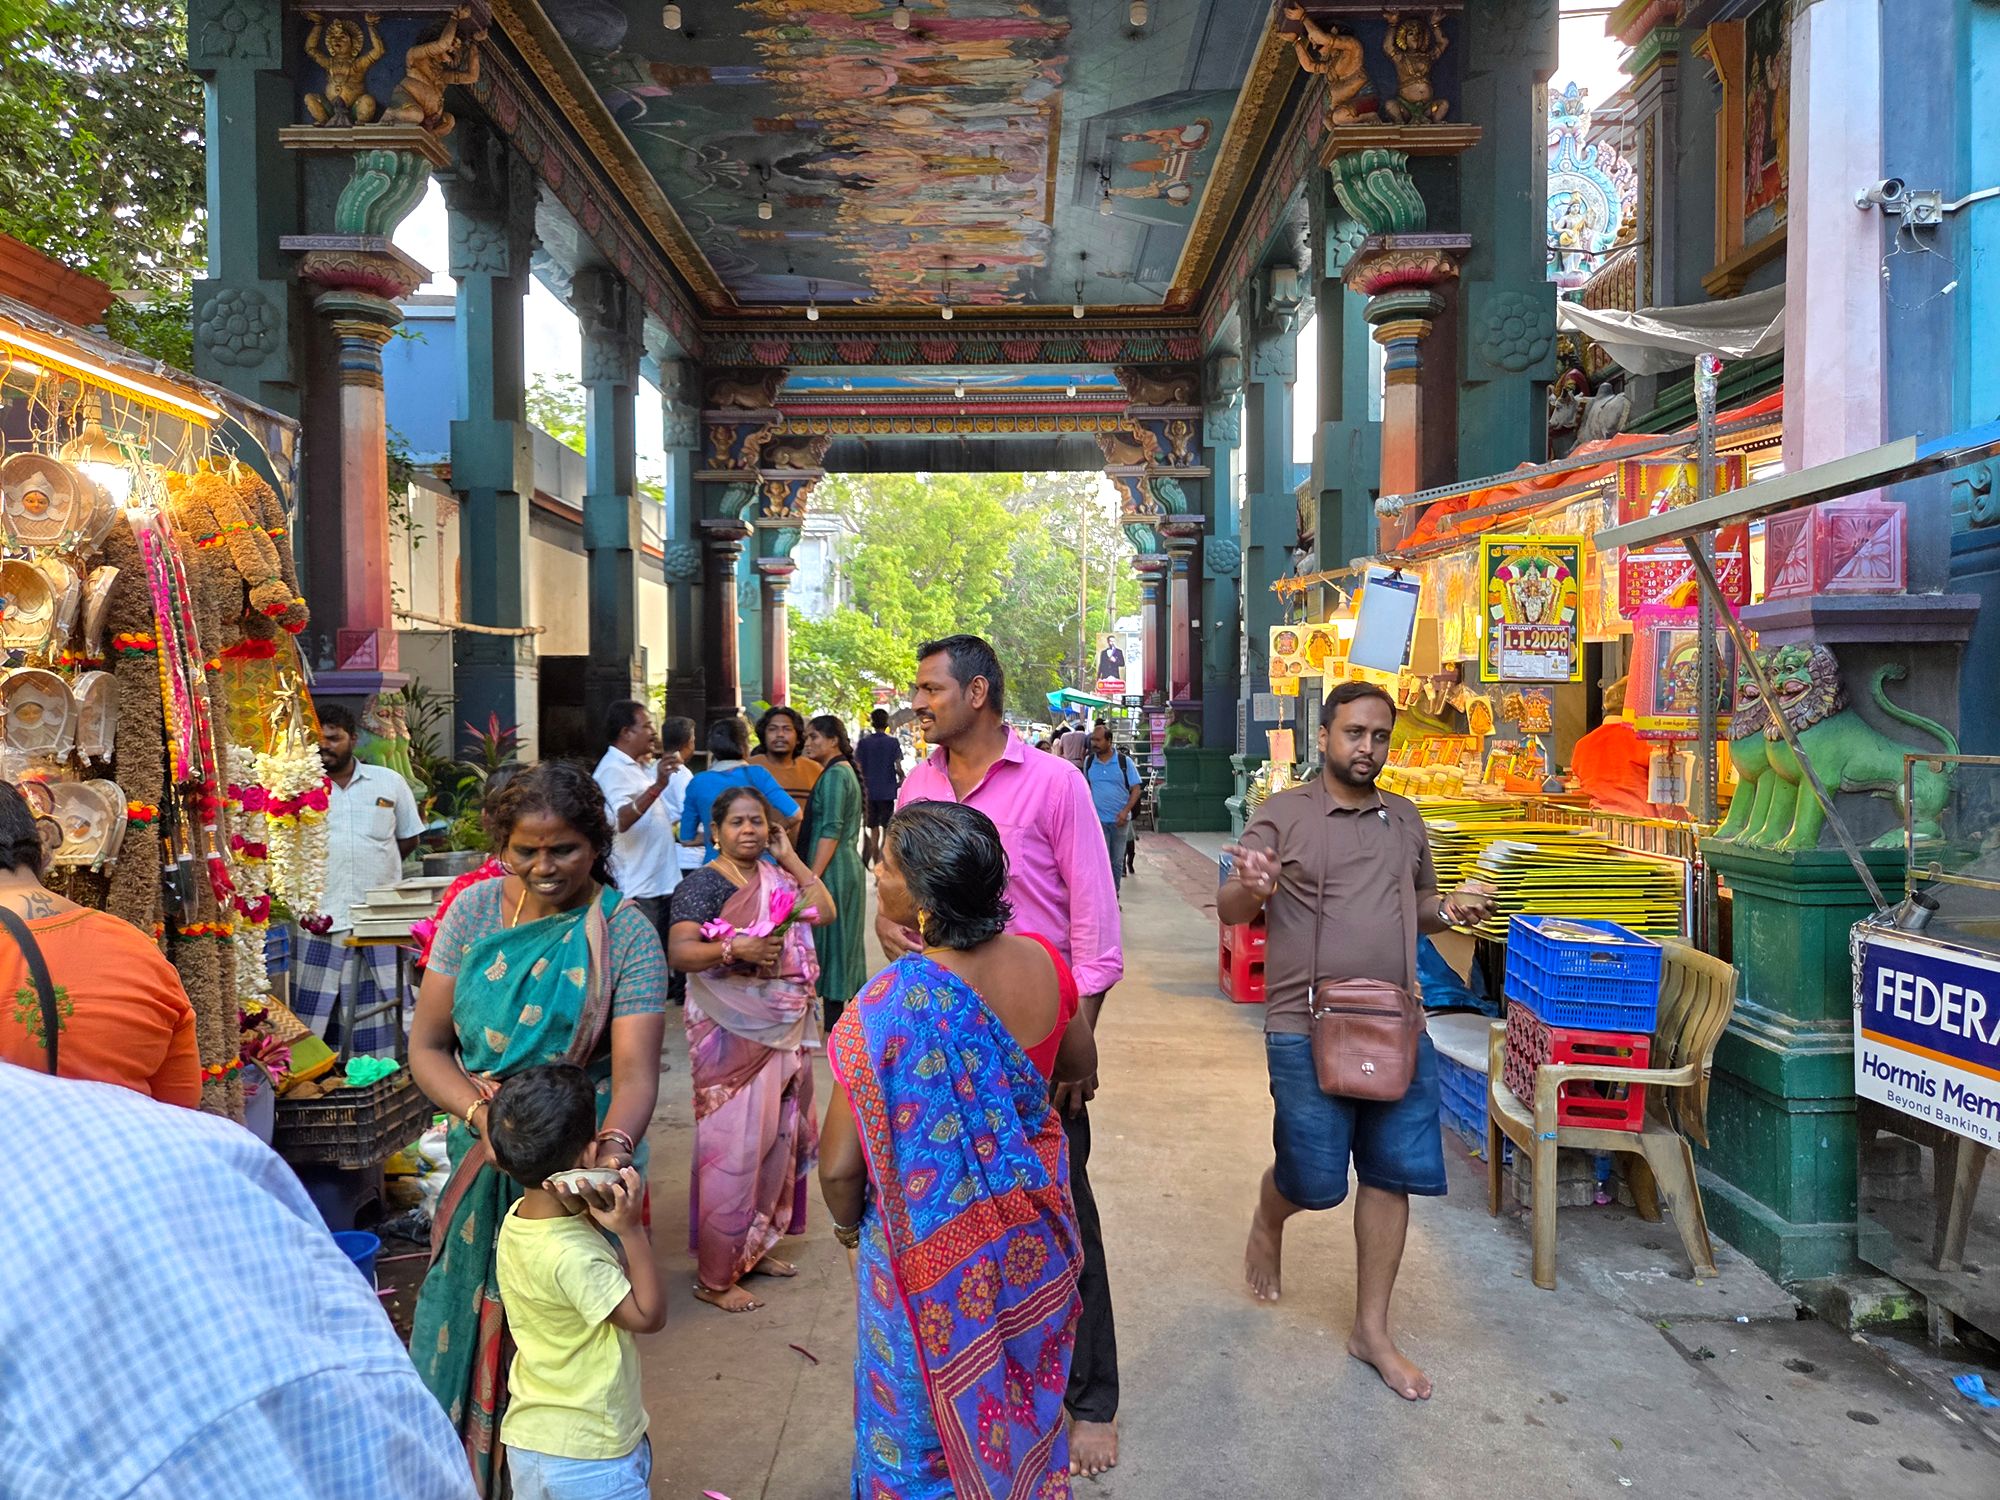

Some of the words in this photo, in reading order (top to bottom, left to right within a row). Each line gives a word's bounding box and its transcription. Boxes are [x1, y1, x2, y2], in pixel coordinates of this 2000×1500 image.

[1862, 1051, 1937, 1098] Hormis
[1943, 1078, 2000, 1122] Mem
[1887, 1089, 1931, 1116] Beyond
[1935, 1108, 1992, 1141] Banking,
